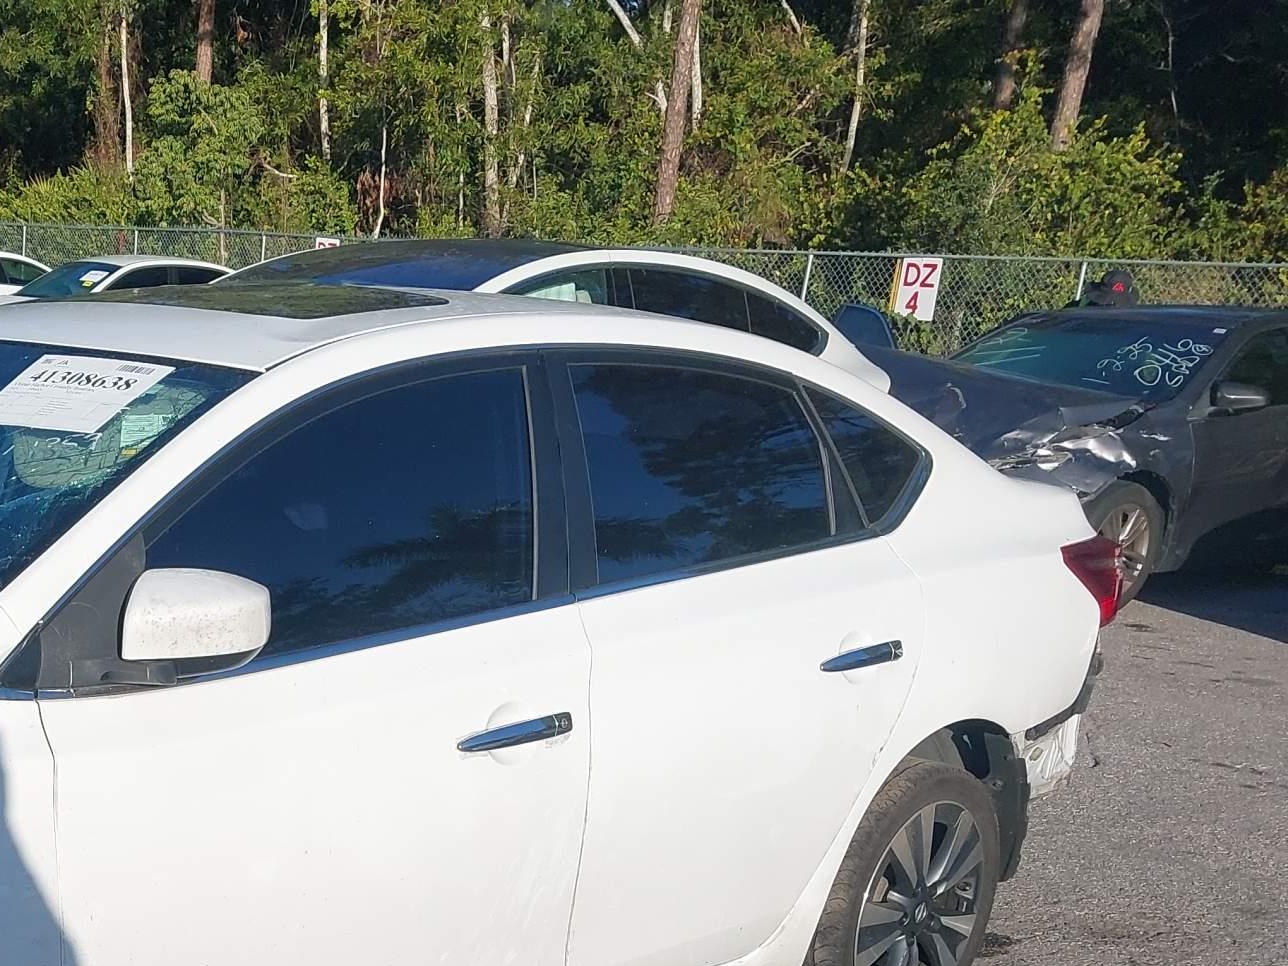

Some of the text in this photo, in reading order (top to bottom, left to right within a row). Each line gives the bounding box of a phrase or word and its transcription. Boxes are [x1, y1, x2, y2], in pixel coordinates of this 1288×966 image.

[903, 262, 938, 288] DZ
[905, 291, 919, 314] 4
[30, 369, 139, 391] 41308638
